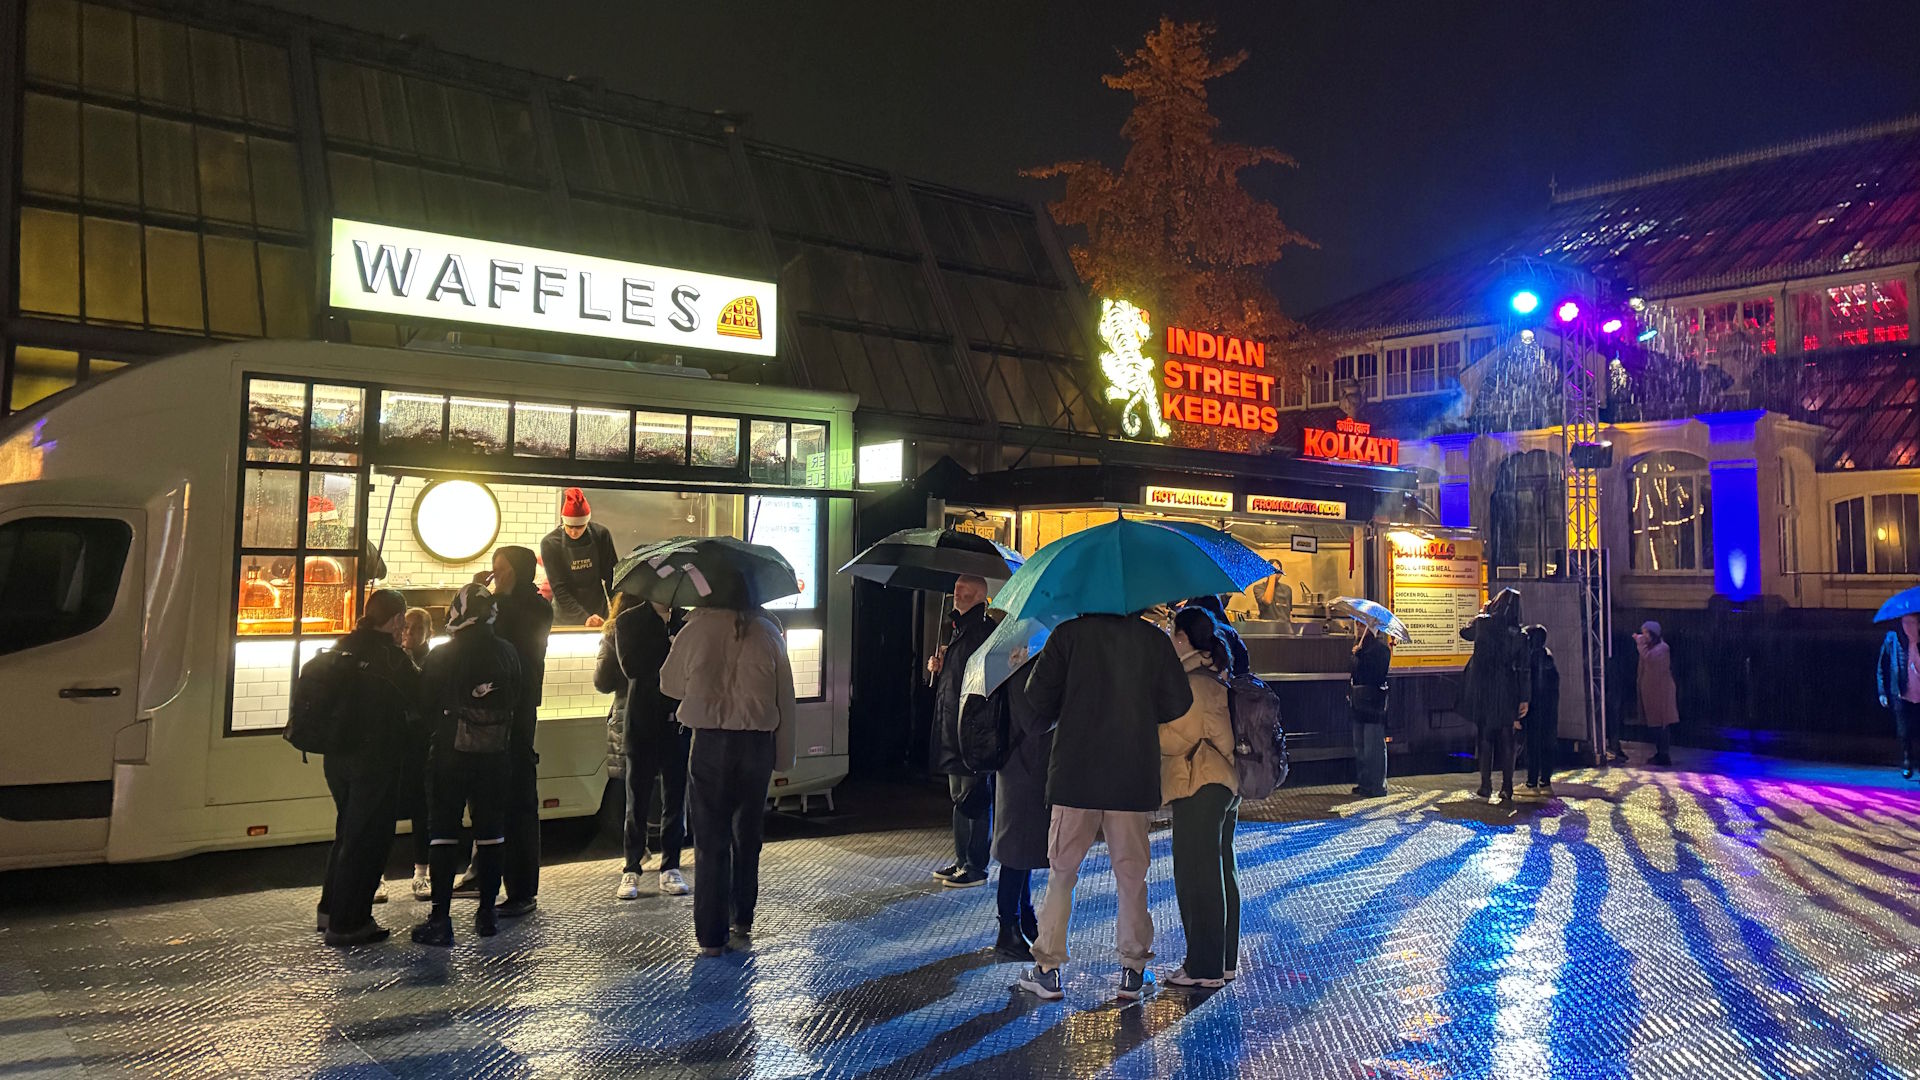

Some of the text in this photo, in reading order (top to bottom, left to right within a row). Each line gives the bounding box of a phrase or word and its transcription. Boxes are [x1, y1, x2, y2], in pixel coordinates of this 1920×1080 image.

[352, 239, 701, 333] WAFFLES
[1167, 326, 1265, 368] INDIAN
[1163, 360, 1275, 401] STREET
[1163, 392, 1279, 433] KEBABS
[1303, 427, 1400, 466] KOLKATI
[1152, 490, 1176, 503] HOT
[1197, 494, 1228, 507] ROLLS
[1252, 498, 1341, 516] FROM KOLKATA INDIA
